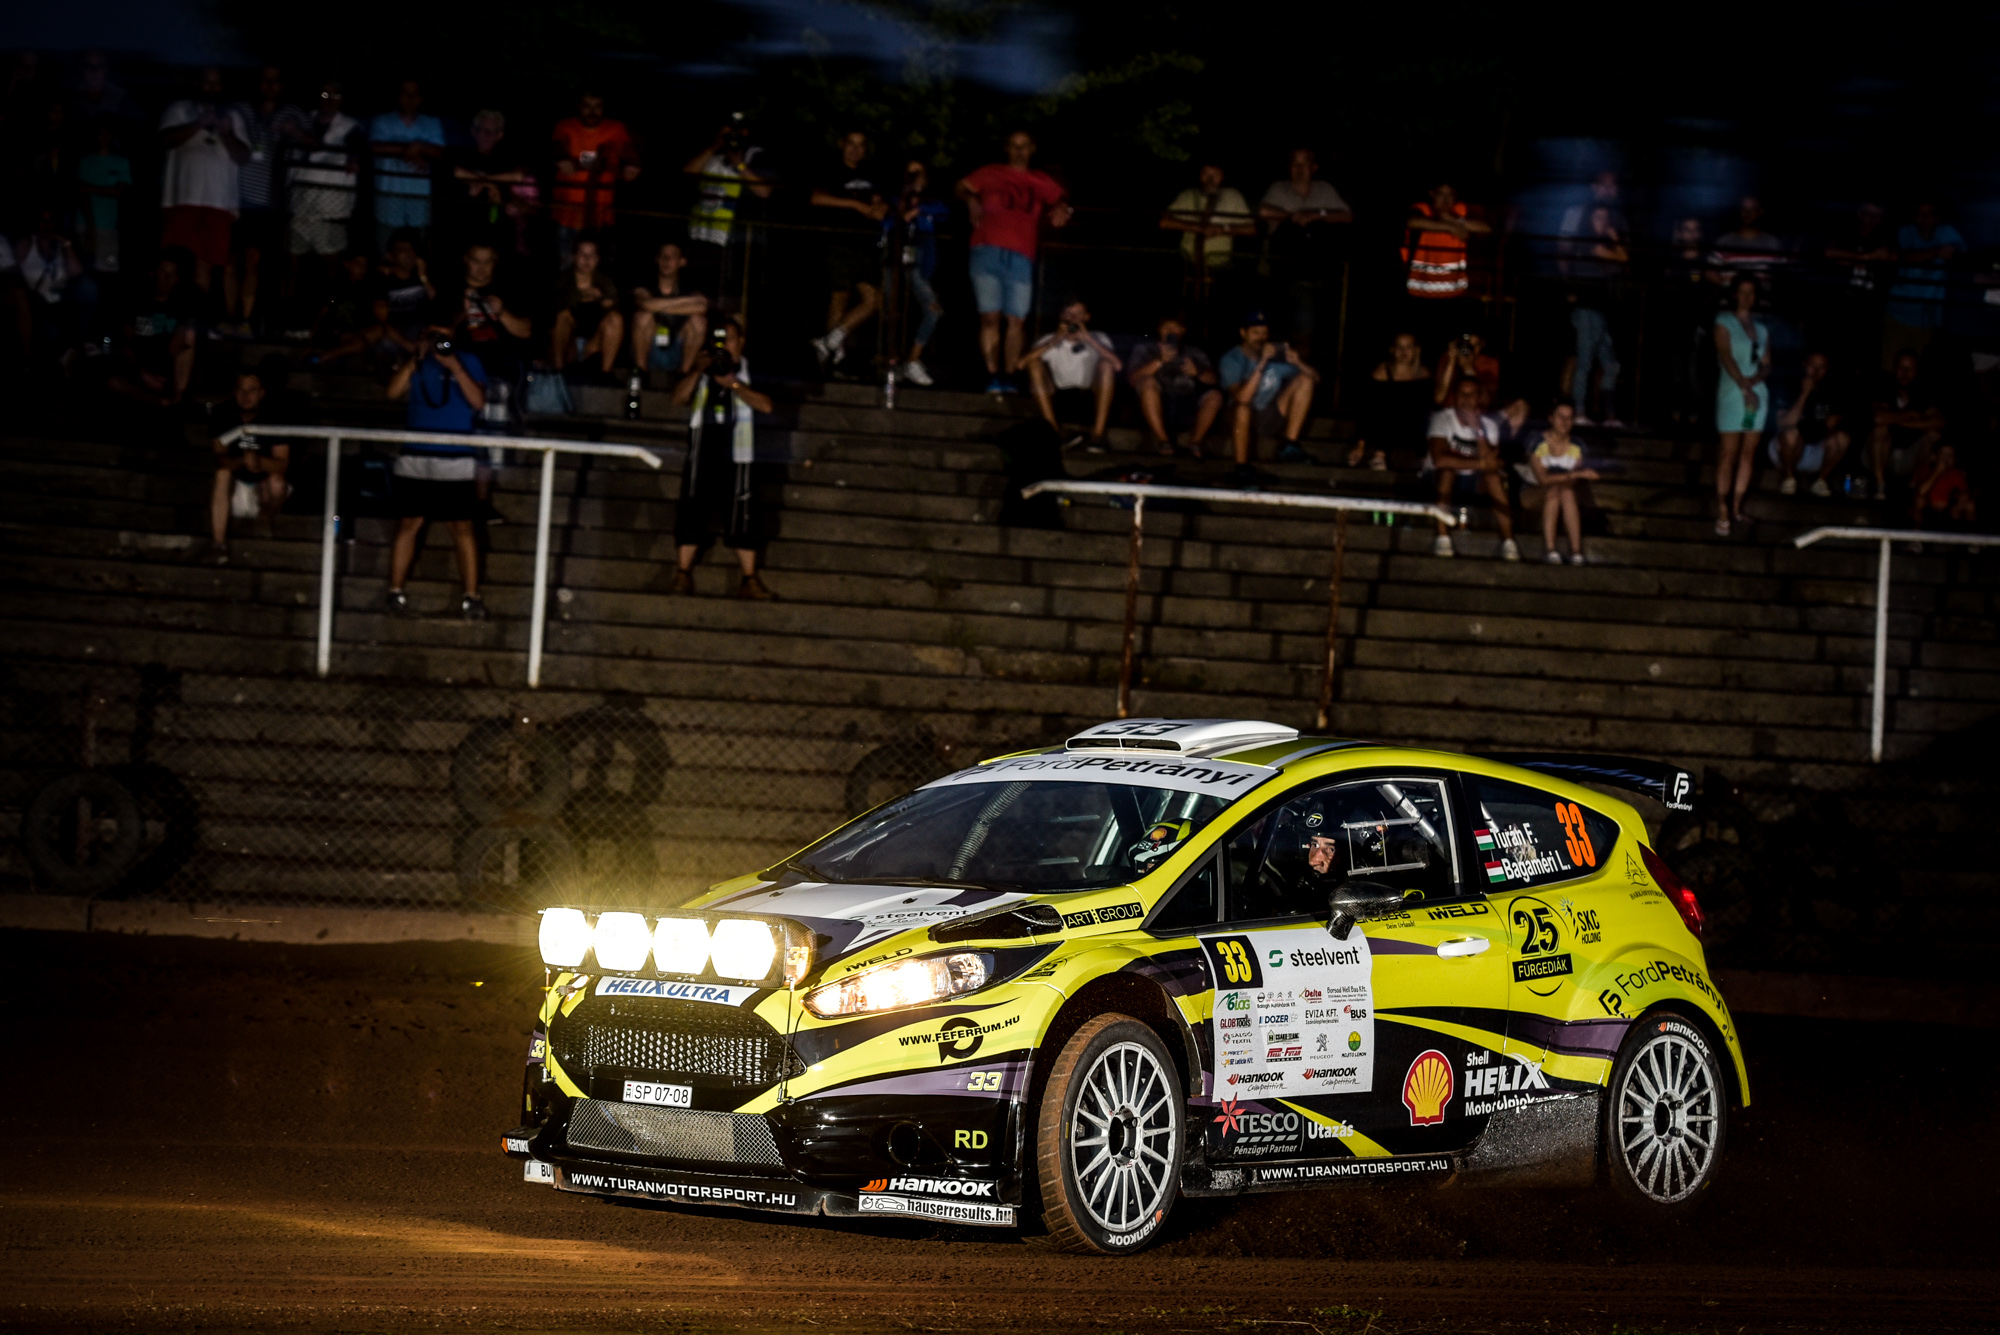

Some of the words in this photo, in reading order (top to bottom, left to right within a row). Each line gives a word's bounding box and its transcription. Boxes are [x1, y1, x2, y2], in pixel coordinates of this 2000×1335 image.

[1092, 722, 1194, 737] 33
[1489, 824, 1526, 849] Turán
[1522, 822, 1539, 845] F.
[1555, 802, 1596, 867] 33
[1501, 851, 1558, 883] Bagaméri
[1555, 849, 1572, 872] L.
[875, 909, 970, 920] steelvent
[1067, 911, 1091, 927] ART
[1099, 904, 1141, 921] GROUP
[1577, 909, 1600, 932] SKC
[1513, 907, 1560, 959] 25
[1581, 931, 1602, 945] HOLDING
[1218, 940, 1253, 983] 33
[1290, 946, 1360, 968] steelvent
[605, 979, 666, 995] HELIX
[667, 984, 731, 1003] ULTRA
[1304, 989, 1322, 998] Delta
[1264, 1014, 1289, 1024] DOZER
[1305, 1009, 1325, 1019] EVIZA
[1326, 1008, 1339, 1018] KFT.
[898, 1015, 1020, 1047] WWW.FEFERRUM.HU
[1466, 1050, 1490, 1067] Shell
[967, 1072, 1003, 1091] 33
[1464, 1053, 1550, 1098] HELIX
[634, 1084, 652, 1100] SP
[655, 1086, 689, 1104] 07-08
[1236, 1112, 1299, 1135] TESCO
[1307, 1119, 1354, 1140] Utazás
[954, 1129, 989, 1149] RD
[1233, 1143, 1268, 1156] Pénzügyi
[1269, 1143, 1298, 1154] Partner
[1260, 1159, 1448, 1181] WWW.TURANMOTORSPORT.HU
[571, 1172, 796, 1206] WWW.TURANMOTORSPORT.HU
[907, 1198, 1011, 1223] hauserresults.hu
